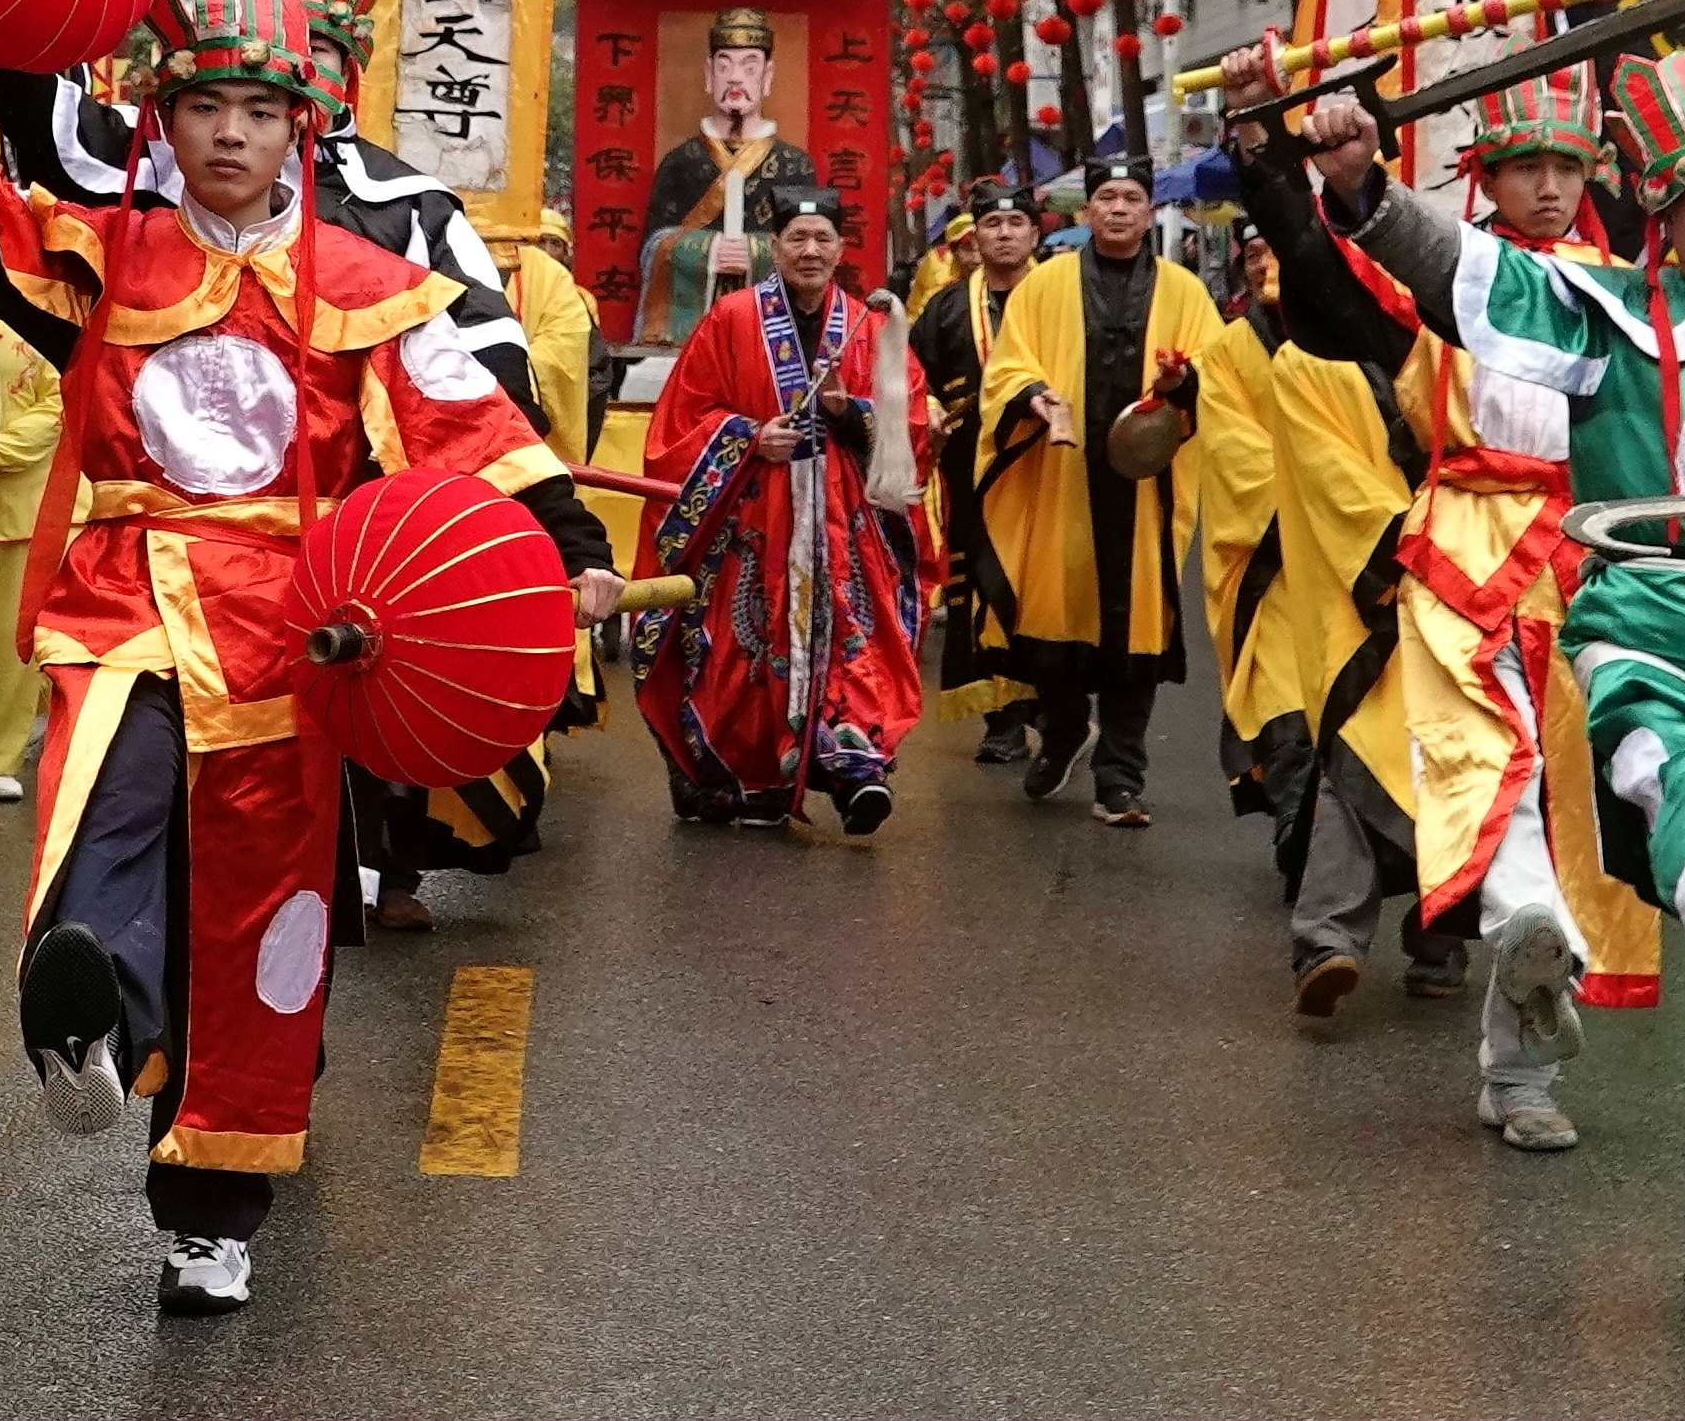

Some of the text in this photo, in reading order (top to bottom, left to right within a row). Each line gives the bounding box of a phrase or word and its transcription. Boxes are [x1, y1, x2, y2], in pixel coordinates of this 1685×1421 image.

[584, 32, 643, 302] 下界保平安
